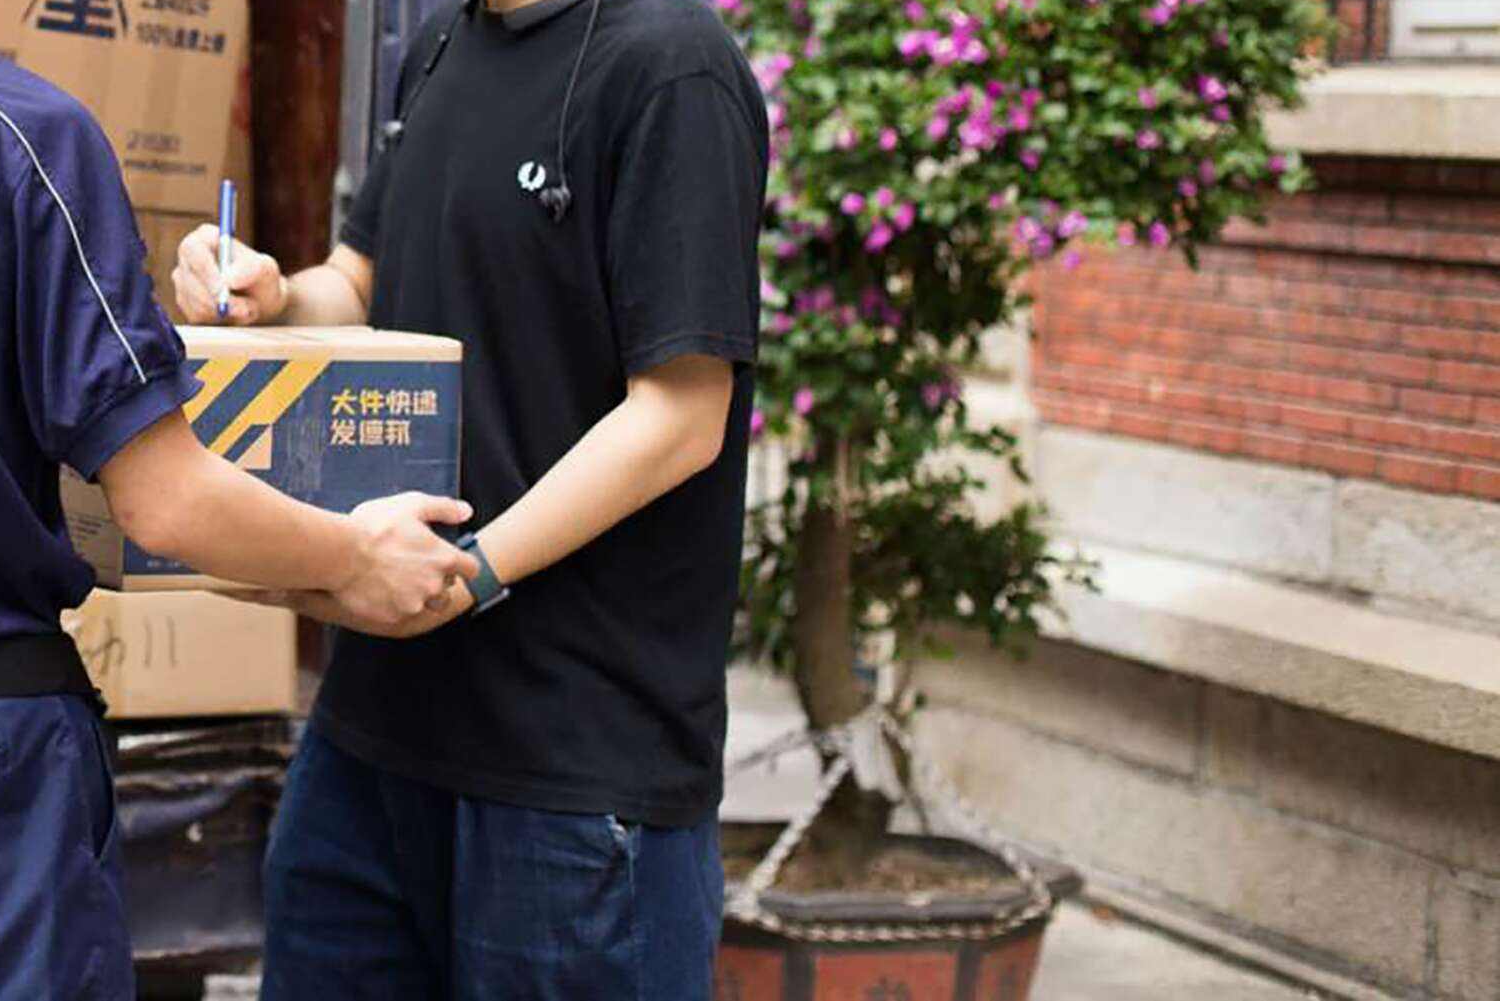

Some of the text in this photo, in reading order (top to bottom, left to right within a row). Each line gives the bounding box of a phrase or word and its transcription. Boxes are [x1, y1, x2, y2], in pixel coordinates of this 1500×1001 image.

[331, 388, 438, 416] 大件快递
[329, 418, 411, 446] 发德邦
